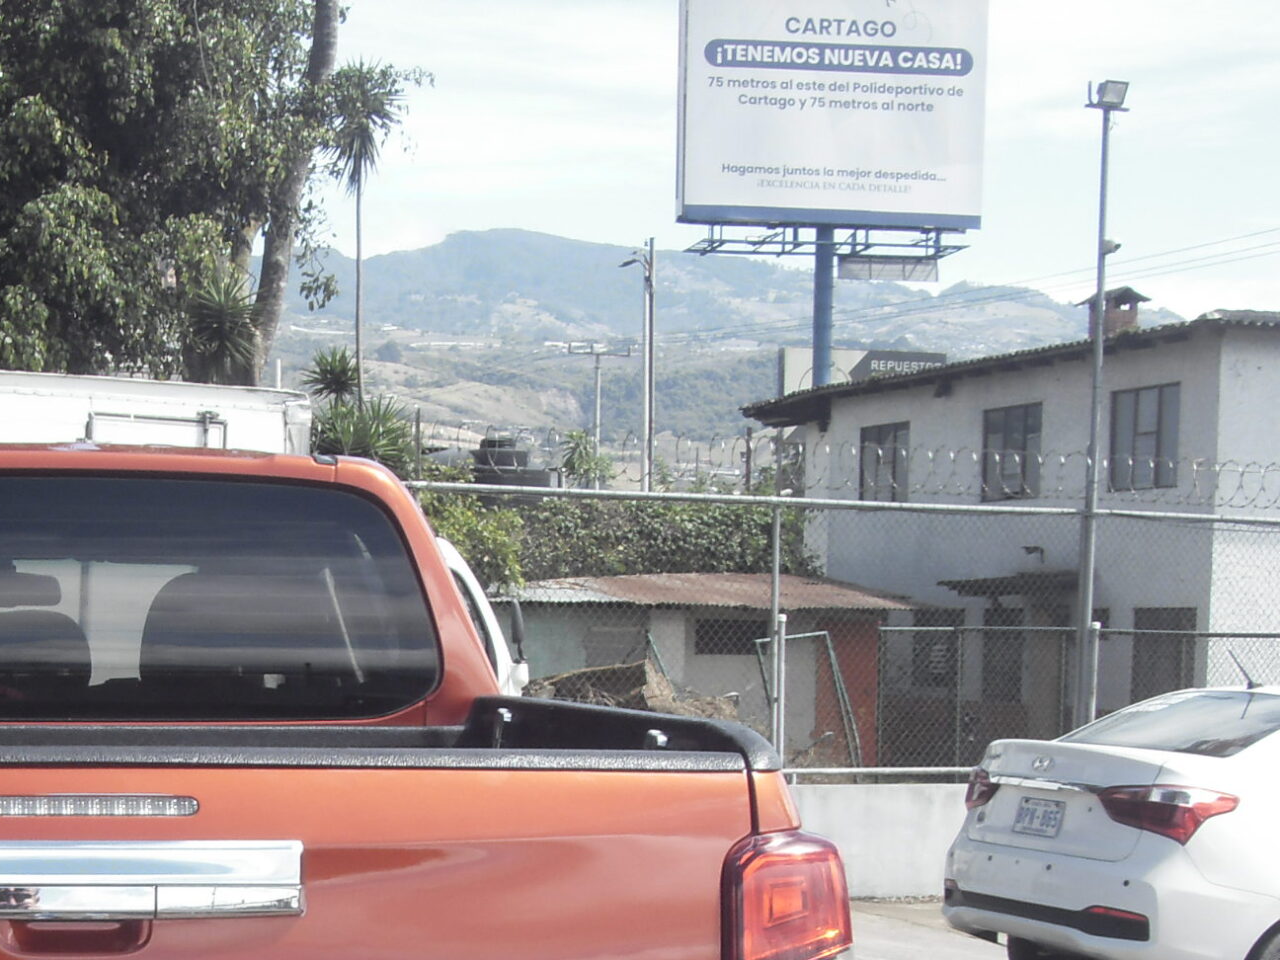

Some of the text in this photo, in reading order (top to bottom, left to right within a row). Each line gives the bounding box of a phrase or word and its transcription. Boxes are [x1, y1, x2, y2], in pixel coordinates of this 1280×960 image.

[785, 16, 897, 37] CARTAGO
[716, 44, 962, 70] ¡TENEMOS NUEVA CASA!
[708, 76, 964, 98] 75 metros al este del Polideportivo de
[738, 94, 935, 113] Cartago y 75 metros al norte
[721, 163, 946, 183] Hagamos juntos la mejor despedida...
[822, 182, 837, 191] EN
[838, 182, 866, 192] CADA
